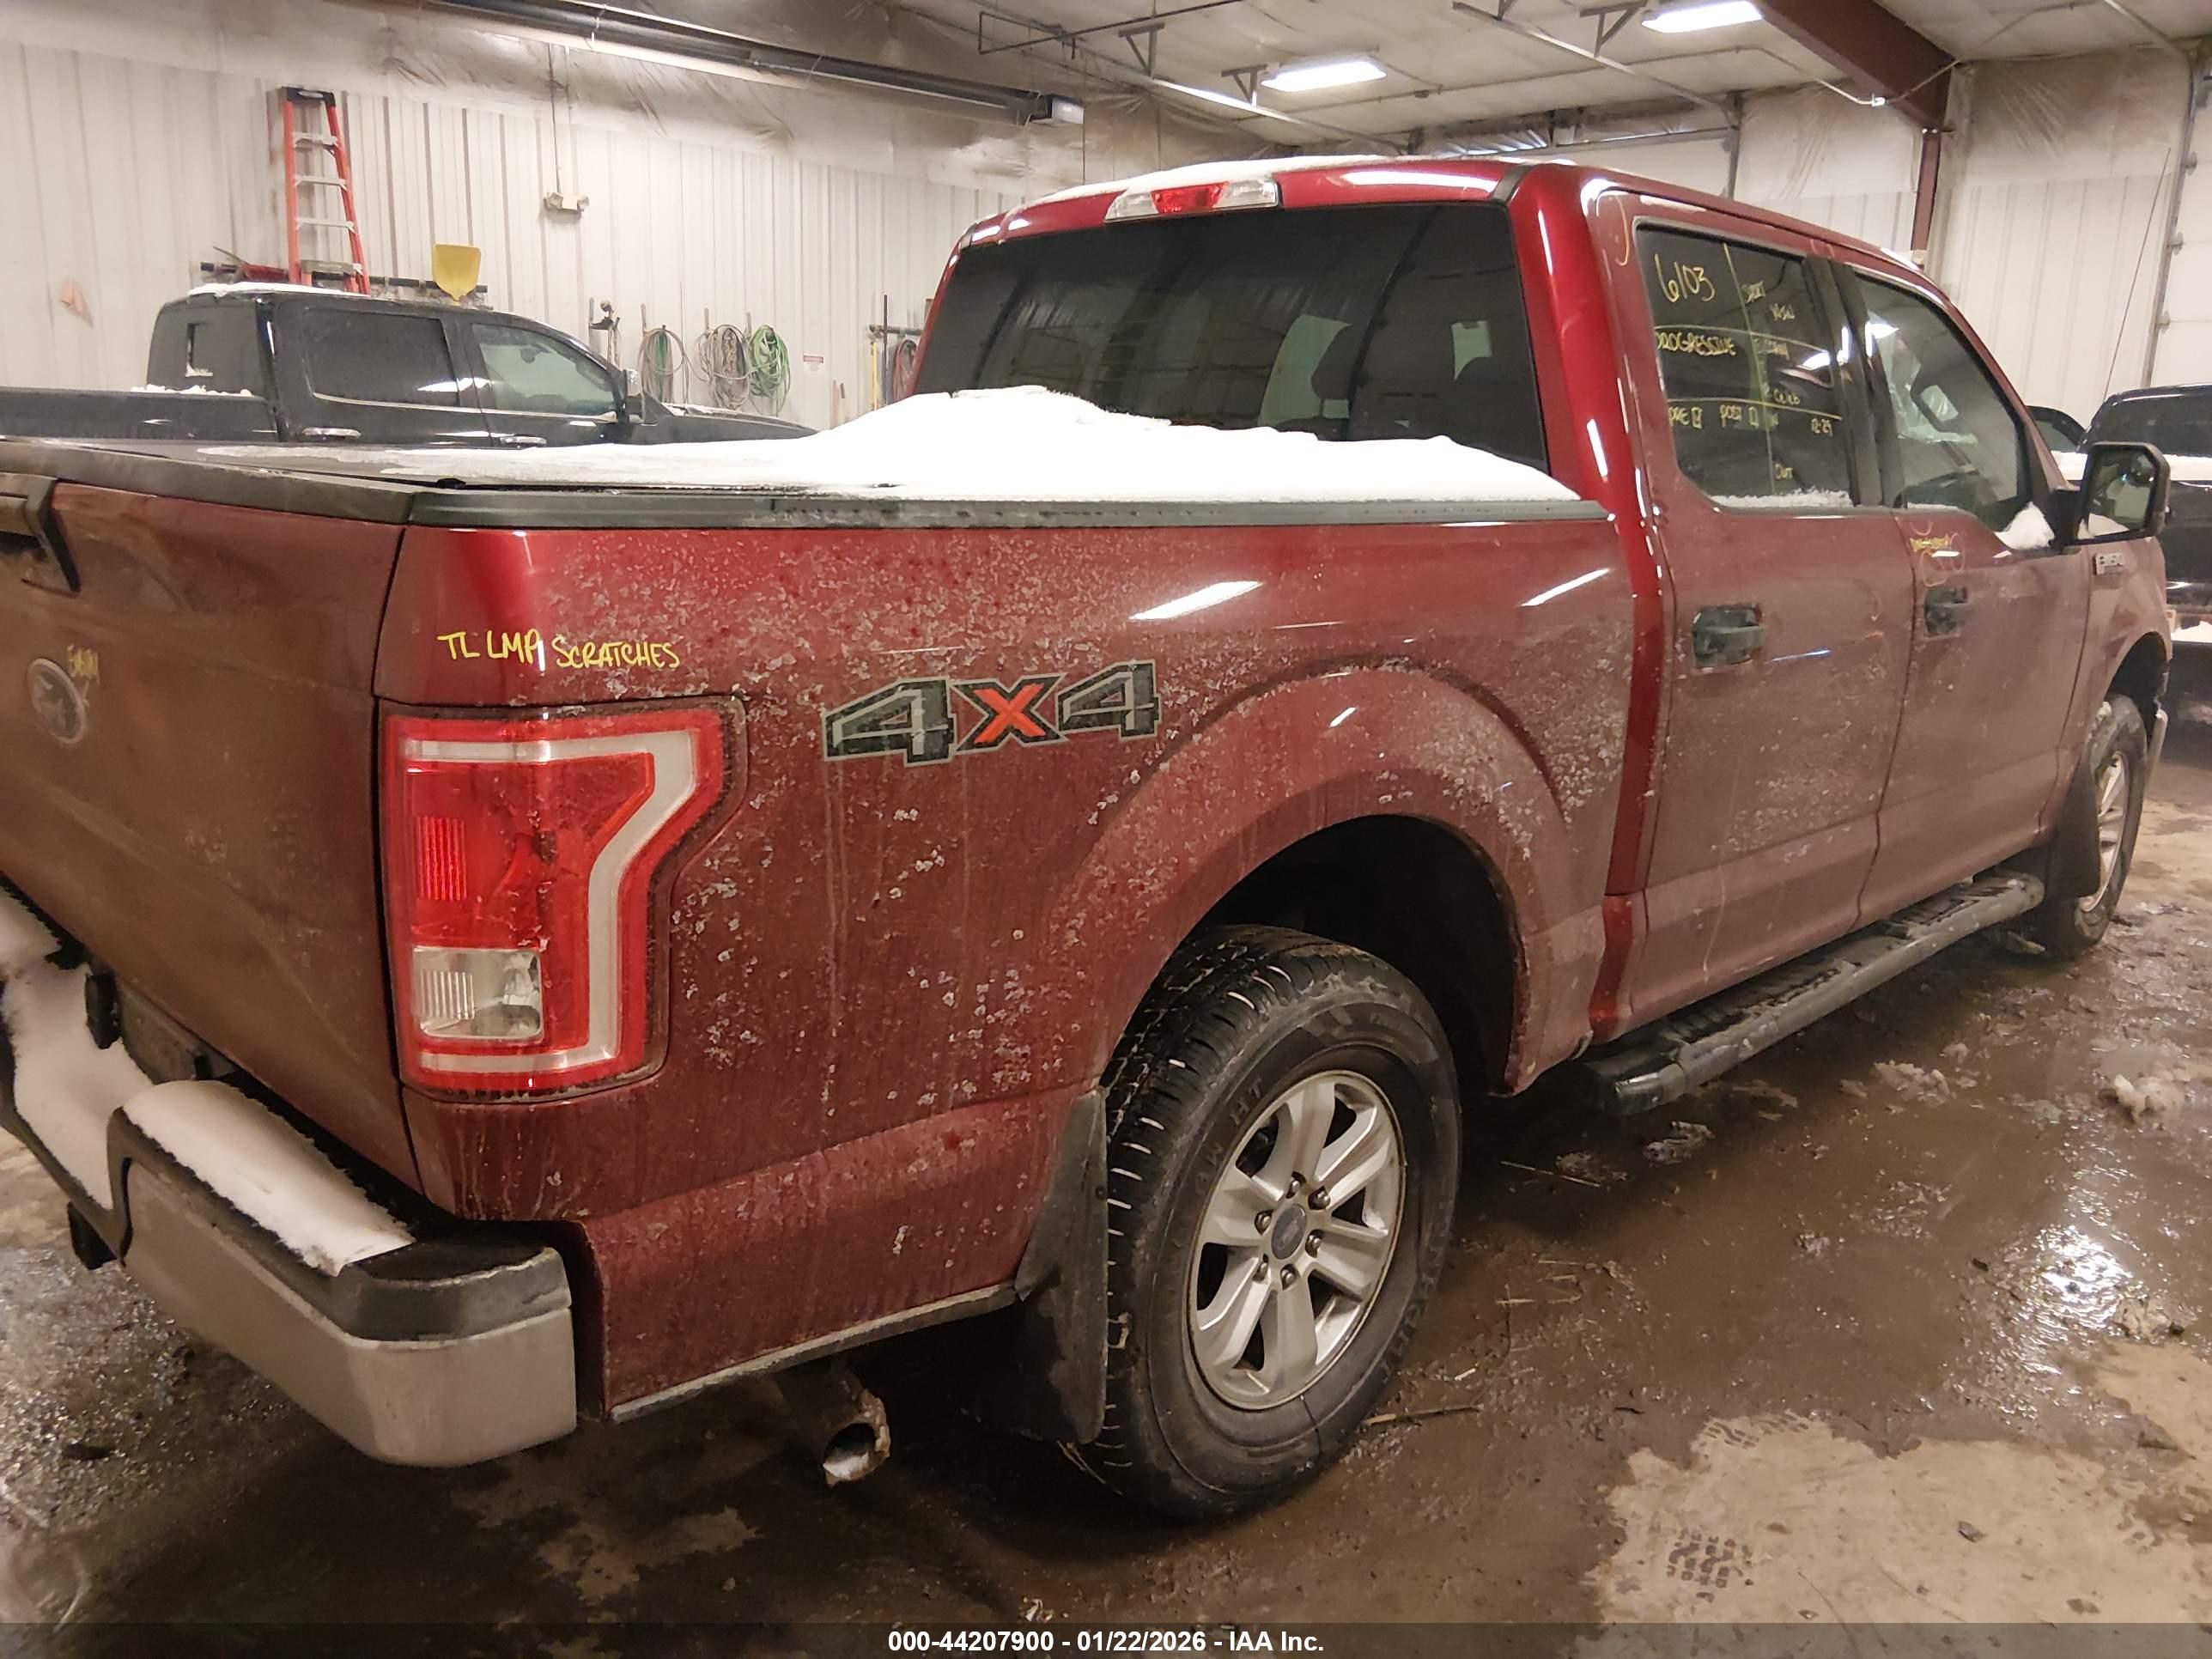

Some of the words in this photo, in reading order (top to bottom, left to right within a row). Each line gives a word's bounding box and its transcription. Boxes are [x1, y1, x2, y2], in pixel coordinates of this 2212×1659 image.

[1654, 253, 1715, 302] 6103
[437, 631, 480, 659] TL
[486, 628, 541, 665] LMP
[551, 634, 681, 669] SCRATCHES
